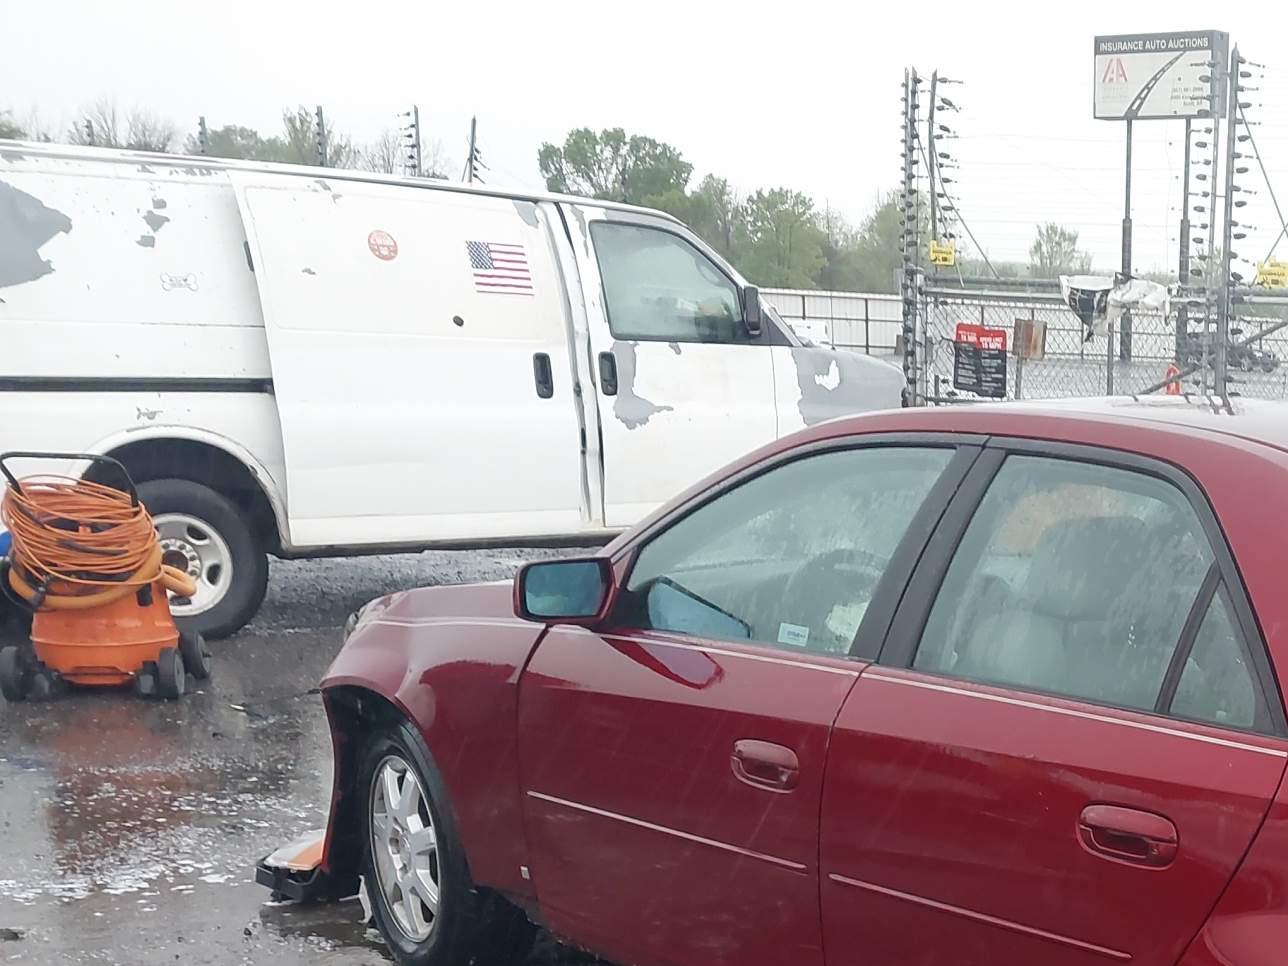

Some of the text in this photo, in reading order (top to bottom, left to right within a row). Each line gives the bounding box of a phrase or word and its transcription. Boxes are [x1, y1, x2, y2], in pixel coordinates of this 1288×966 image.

[1100, 37, 1209, 52] INSURANCE AUTO AUCTIONS
